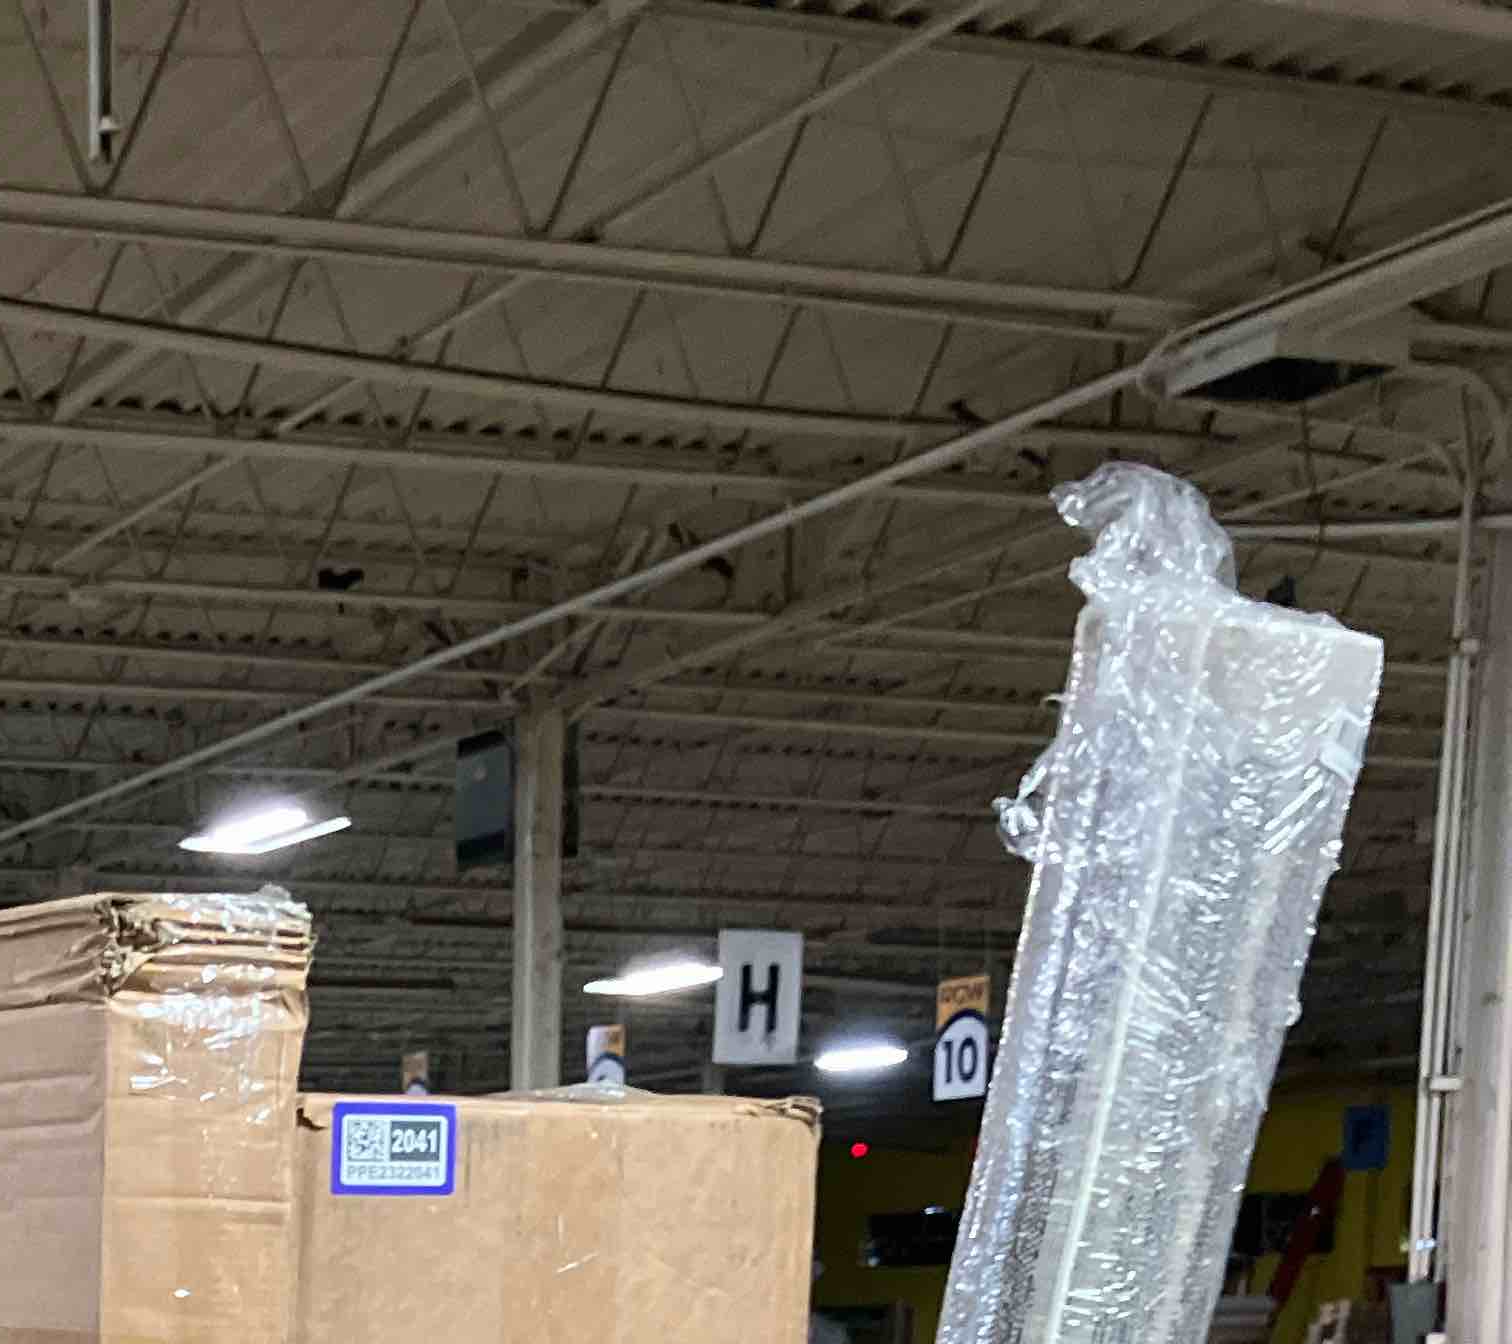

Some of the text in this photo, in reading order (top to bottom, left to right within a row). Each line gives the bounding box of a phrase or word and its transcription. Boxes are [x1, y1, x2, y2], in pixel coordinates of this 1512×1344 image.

[738, 963, 780, 1034] H
[943, 1036, 977, 1084] 10
[391, 1129, 440, 1153] 2041
